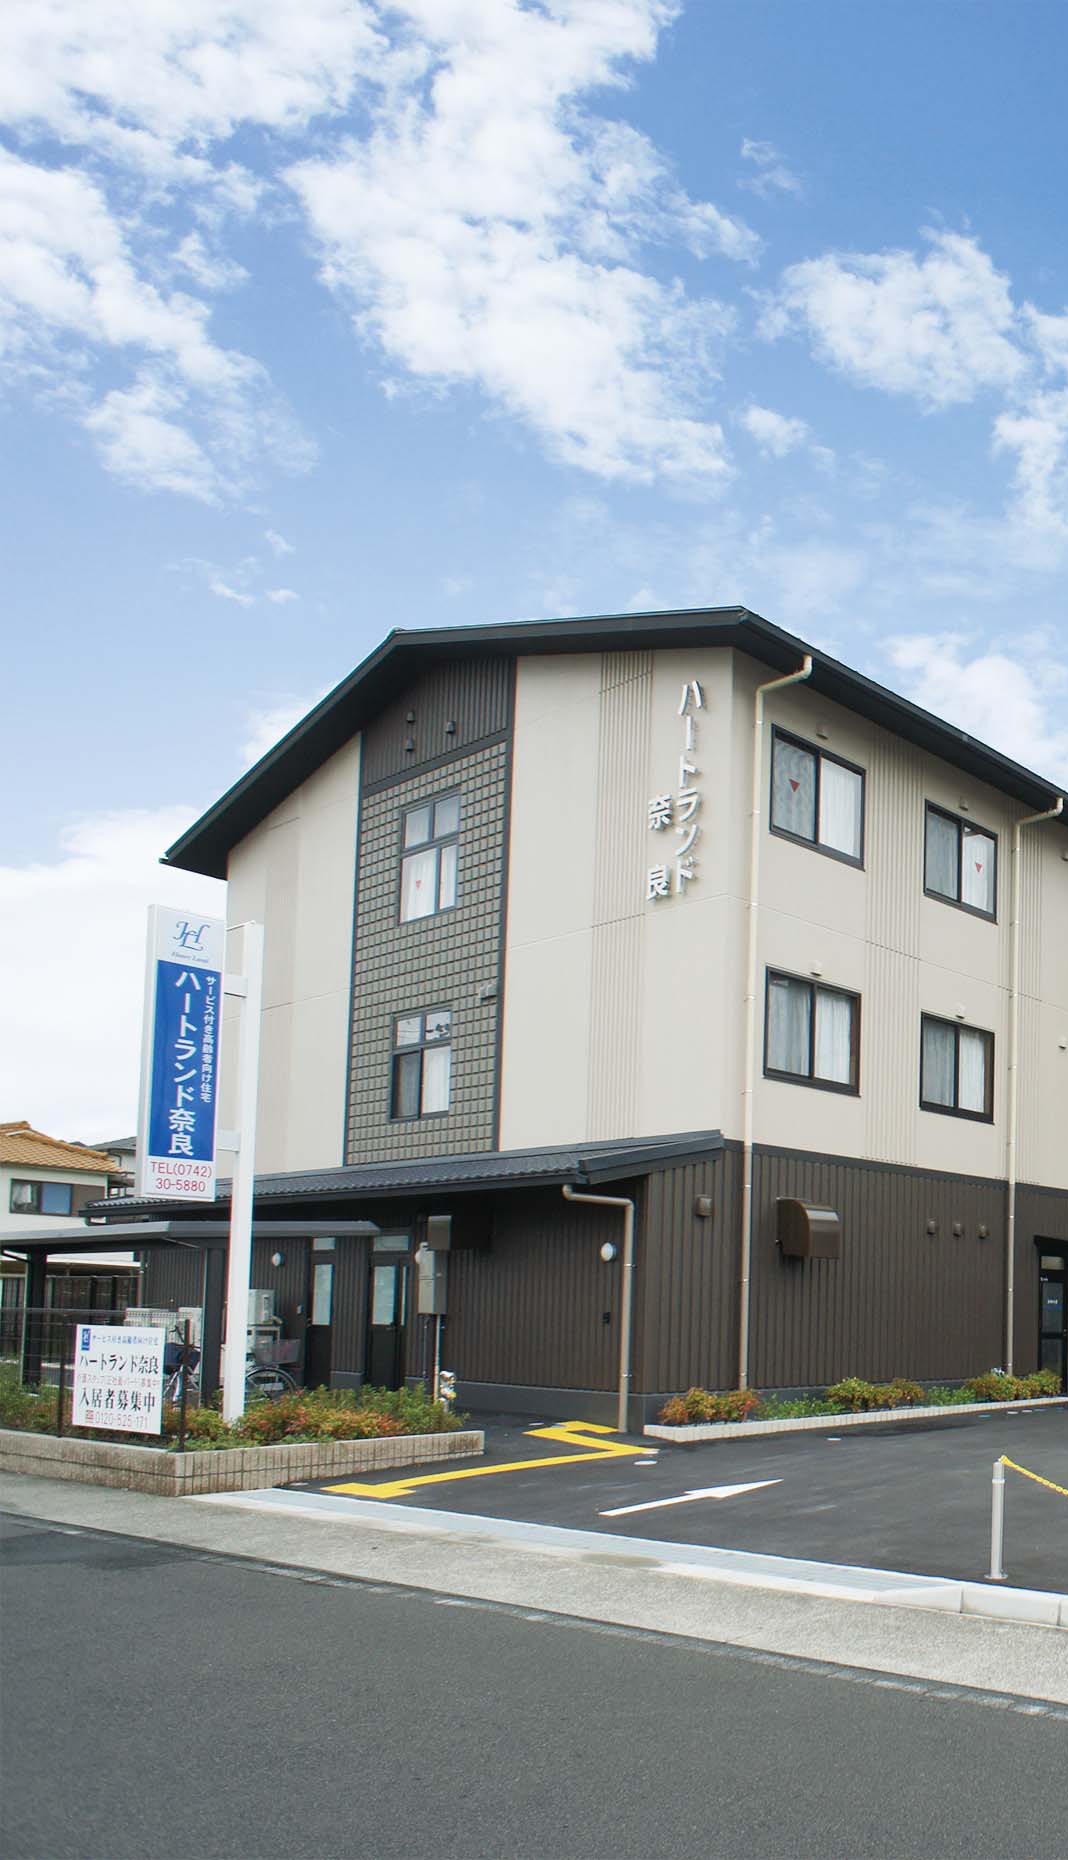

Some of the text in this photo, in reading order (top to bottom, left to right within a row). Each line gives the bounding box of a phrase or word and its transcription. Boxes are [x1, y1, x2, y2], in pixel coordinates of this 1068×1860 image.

[676, 679, 704, 896] ハートランド
[647, 793, 673, 902] 奈良
[168, 971, 201, 1156] ハートランド奈良
[151, 1161, 213, 1178] TEL(0742)
[155, 1178, 206, 1192] 30-5880
[80, 1353, 159, 1374] ハートランド奈良
[80, 1387, 155, 1412] 入居者募集中
